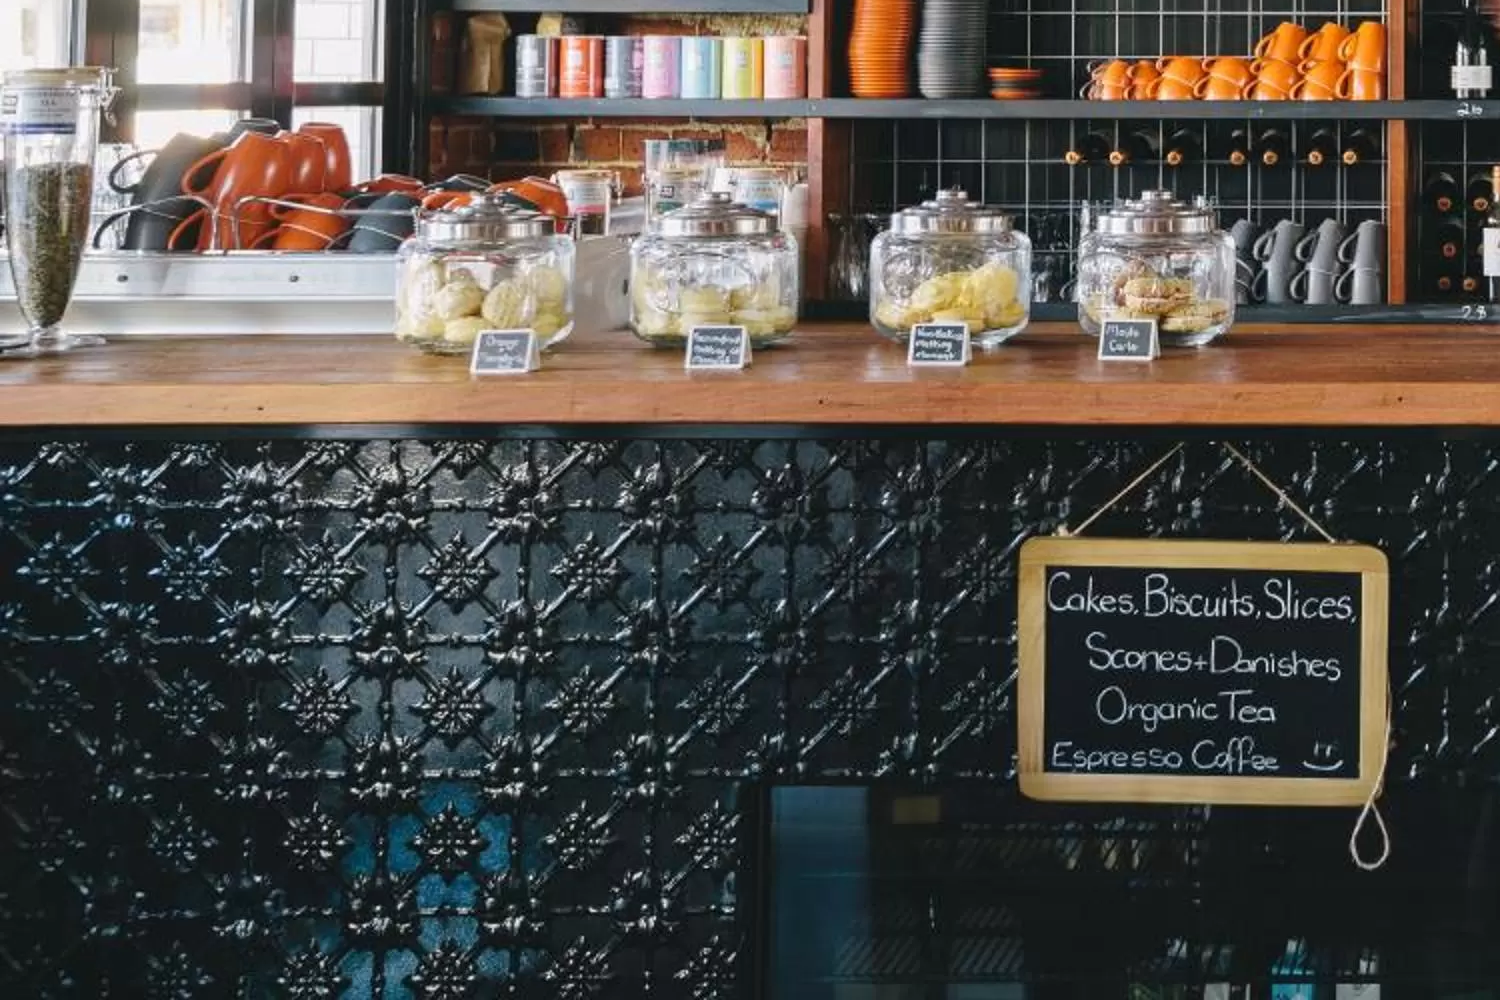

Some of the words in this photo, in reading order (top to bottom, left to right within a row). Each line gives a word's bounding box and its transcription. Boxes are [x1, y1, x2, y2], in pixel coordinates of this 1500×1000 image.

[1096, 684, 1218, 733] Organic
[1218, 689, 1278, 723] Tea
[1052, 740, 1183, 774] Espresso
[1191, 735, 1281, 775] Coffee
